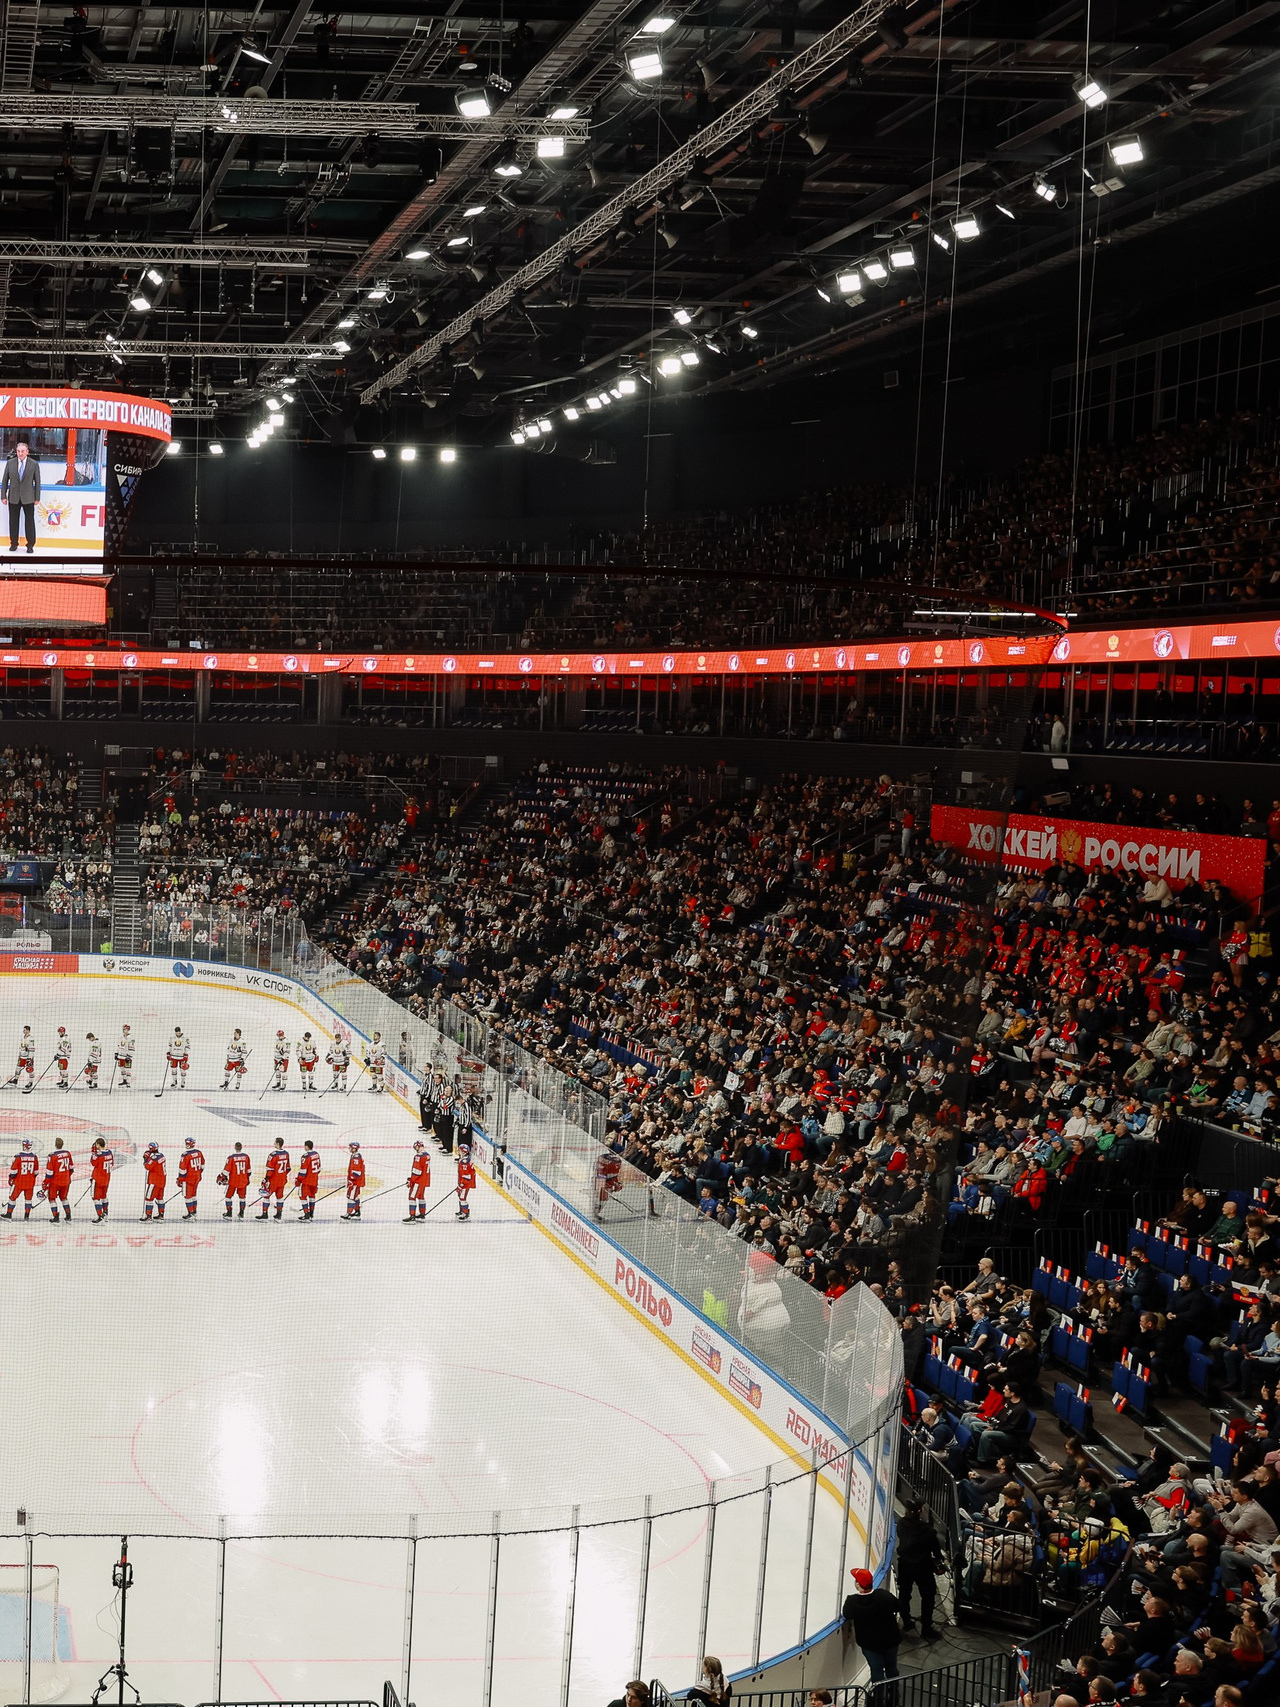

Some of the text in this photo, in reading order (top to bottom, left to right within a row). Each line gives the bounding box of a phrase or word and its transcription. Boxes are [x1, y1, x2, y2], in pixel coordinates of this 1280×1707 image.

[15, 397, 69, 418] КУБОК
[70, 398, 129, 423] ПЕРВОГО
[131, 404, 164, 432] КАНАЛА
[967, 822, 1201, 881] ХОККЕЙ РОССИИ
[197, 969, 236, 980] НОРНИКЕЛЬ
[246, 974, 293, 995] VK СПОРТ
[21, 1161, 34, 1175] 89
[58, 1158, 70, 1172] 24
[190, 1157, 202, 1172] 44
[235, 1162, 246, 1175] 14
[277, 1159, 288, 1173] 27
[615, 1257, 673, 1327] РОЛЬФ
[786, 1407, 858, 1497] RED MACHIE
